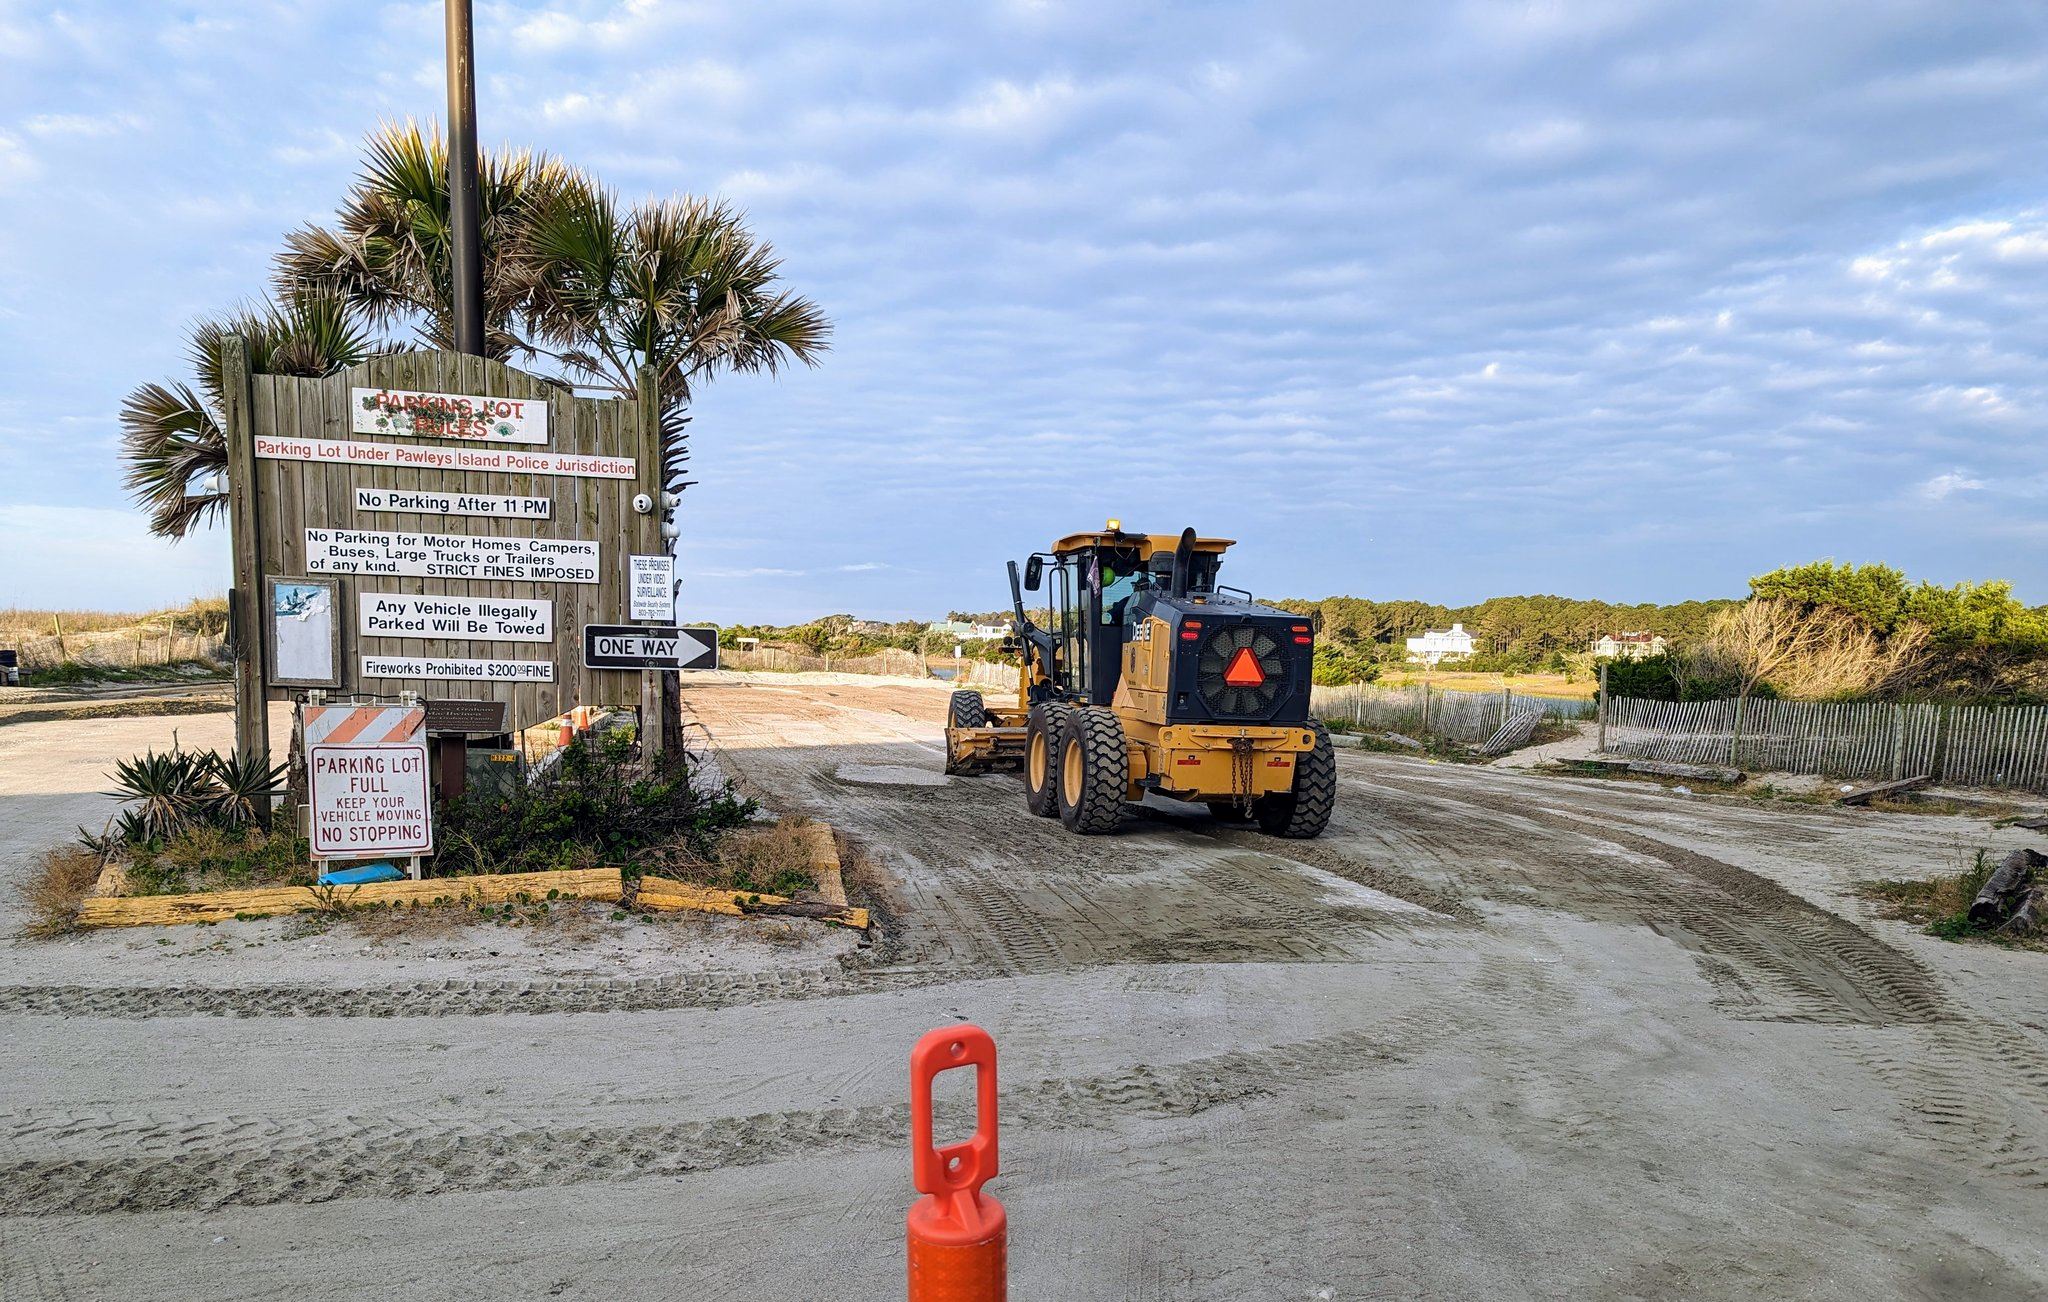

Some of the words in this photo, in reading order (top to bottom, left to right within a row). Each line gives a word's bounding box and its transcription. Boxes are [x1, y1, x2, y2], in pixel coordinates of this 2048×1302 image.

[484, 401, 524, 419] LOT
[416, 417, 487, 437] RULES
[257, 441, 311, 458] Parking
[318, 444, 341, 457] Lot
[348, 446, 389, 460] Under
[396, 449, 452, 466] Pawleys
[458, 453, 500, 467] Island
[507, 456, 549, 469] Police
[556, 459, 635, 474] Jurisdiction
[359, 492, 381, 506] No
[389, 494, 449, 512] Parking
[458, 497, 496, 511] After
[504, 499, 516, 512] 11
[524, 500, 547, 514] PM
[308, 530, 328, 542] No
[335, 532, 389, 547] Parking
[397, 534, 417, 545] for
[424, 536, 465, 548] Motor
[472, 538, 521, 551] Homes
[529, 541, 595, 556] Campers,
[329, 545, 379, 559] Buses,
[386, 548, 427, 562] Large
[433, 550, 480, 563] Trucks
[486, 555, 500, 563] or
[505, 553, 555, 565] Trailers
[310, 559, 325, 569] of
[332, 562, 359, 573] any
[366, 560, 400, 572] kind.
[427, 564, 477, 575] STRICT
[484, 566, 524, 577] FINES
[531, 567, 594, 579] IMPOSED
[376, 600, 406, 615] Any
[414, 601, 471, 616] Vehicle
[478, 604, 538, 620] Illegally
[368, 617, 425, 631] Parked
[432, 618, 460, 632] Will
[467, 620, 488, 633] Be
[495, 621, 545, 635] Towed
[600, 638, 635, 655] ONE
[641, 640, 678, 656] WAY
[366, 661, 421, 675] Fireworks
[426, 662, 483, 676] Prohibited
[317, 757, 385, 774] PARKING
[392, 757, 420, 773] LOT
[351, 777, 389, 793] FULL
[336, 797, 366, 809] KEEP
[372, 796, 405, 808] YOUR
[321, 810, 370, 822] VEHICLE
[377, 809, 422, 821] MOVING
[322, 827, 342, 842] NO
[349, 825, 421, 842] STOPPING
